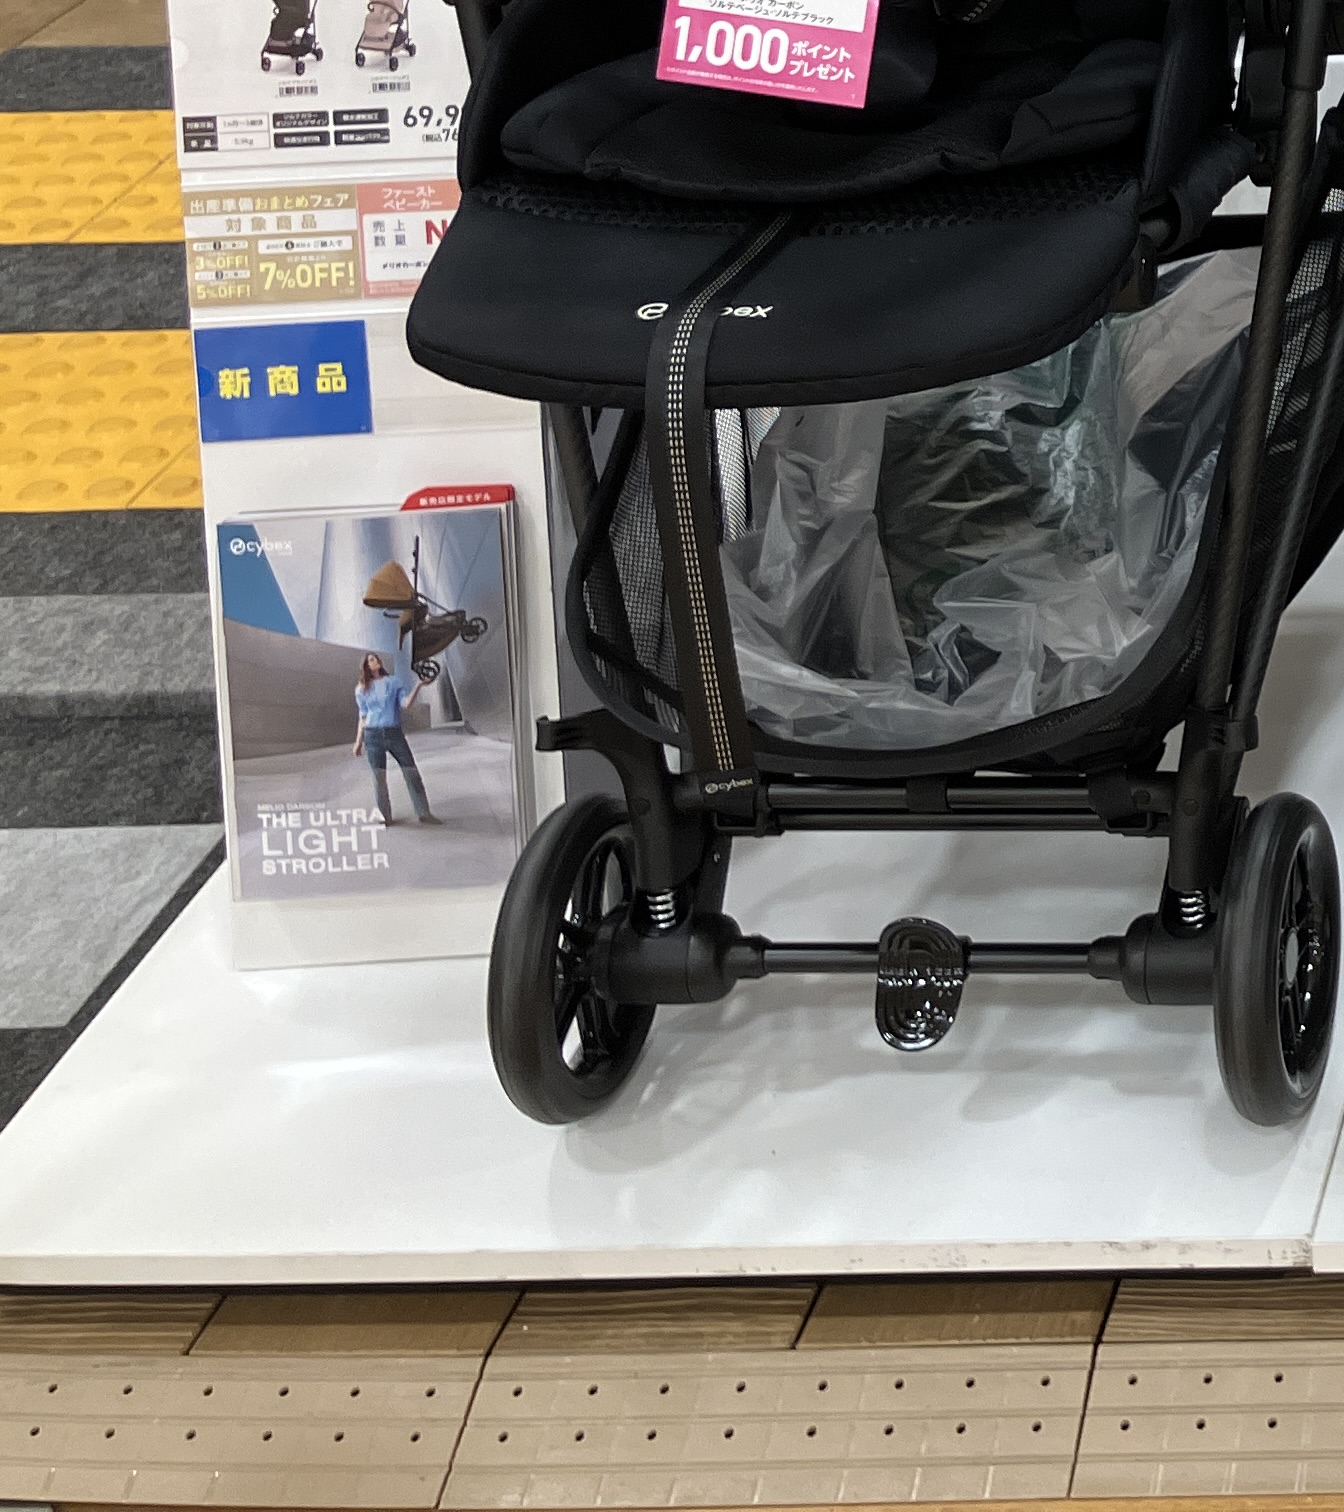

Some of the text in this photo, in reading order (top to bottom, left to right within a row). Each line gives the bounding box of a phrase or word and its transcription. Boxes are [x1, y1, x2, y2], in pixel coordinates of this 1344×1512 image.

[674, 15, 790, 75] 1,000
[791, 40, 851, 63] ポイント
[788, 60, 856, 83] プレゼント
[190, 192, 350, 215] 出産準備おまとめフェア
[382, 187, 436, 200] ファースト
[225, 213, 318, 234] 対象商品
[258, 261, 356, 291] 7%OFF!
[218, 362, 348, 401] 新商品
[246, 537, 293, 557] cybex
[719, 778, 754, 792] cybex
[257, 808, 386, 829] THE ULTRA
[262, 823, 387, 857] LIGHT
[262, 852, 390, 876] STROLLER
